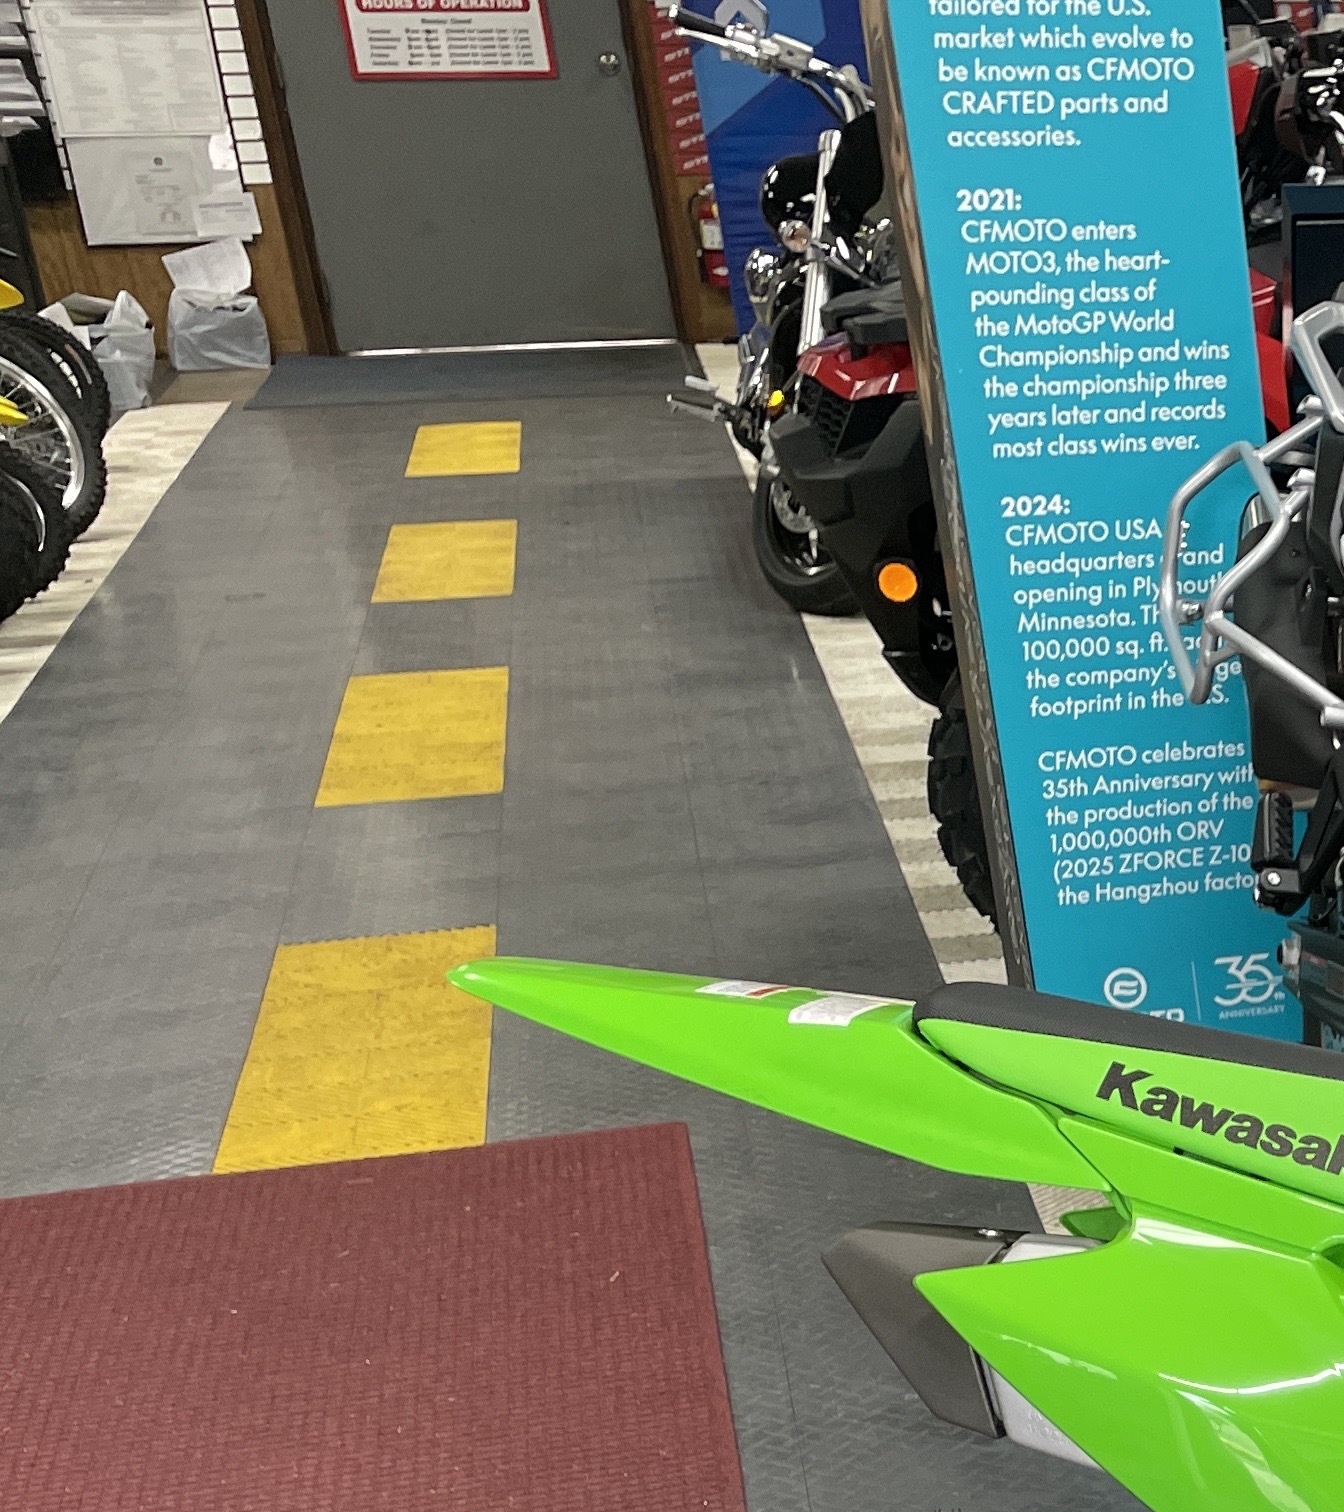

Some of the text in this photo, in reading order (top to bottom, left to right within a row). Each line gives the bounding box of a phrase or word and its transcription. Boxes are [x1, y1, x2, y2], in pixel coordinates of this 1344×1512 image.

[929, 0, 1151, 16] tailored for the U.S.
[934, 24, 1193, 48] market which evolve to
[939, 57, 1194, 82] be known as CFMOTO
[943, 89, 1168, 120] CRAFTED parts and
[947, 125, 1081, 147] accessories.
[957, 188, 1021, 211] 2021:
[961, 218, 1136, 243] CFMOTO enters
[966, 249, 1170, 275] MOTO3, the heart-
[971, 278, 1156, 312] pounding class of
[975, 309, 1174, 336] the MotoGP World
[979, 339, 1229, 372] Championship and wins
[984, 369, 1227, 400] the championship three
[988, 398, 1225, 435] years later and records
[993, 433, 1199, 458] most class wins ever.
[1001, 494, 1070, 517] 2024:
[1006, 518, 1162, 546] CFMOTO USA
[1010, 551, 1154, 578] headquarters
[1014, 582, 1102, 609] opening
[1109, 580, 1126, 598] in
[1018, 609, 1135, 632] Minnesota.
[1023, 637, 1109, 661] 100,000
[1116, 641, 1144, 659] sq.
[1149, 632, 1168, 652] ft.
[1026, 668, 1060, 689] the
[1066, 660, 1176, 689] company's
[1030, 693, 1122, 719] footprint
[1128, 692, 1145, 709] in
[1152, 688, 1184, 707] the
[1039, 741, 1244, 771] CFMOTO celebrates
[1043, 777, 1088, 799] 35th
[1093, 773, 1213, 795] Anniversary
[1046, 792, 1253, 828] the production of the
[1051, 819, 1223, 855] 1,000,000th ORV
[1054, 856, 1113, 884] (2025
[1120, 847, 1203, 873] ZFORCE
[1058, 886, 1089, 905] the
[1096, 877, 1198, 903] Hangzhou
[1219, 1005, 1285, 1020] ANNIVERSARY
